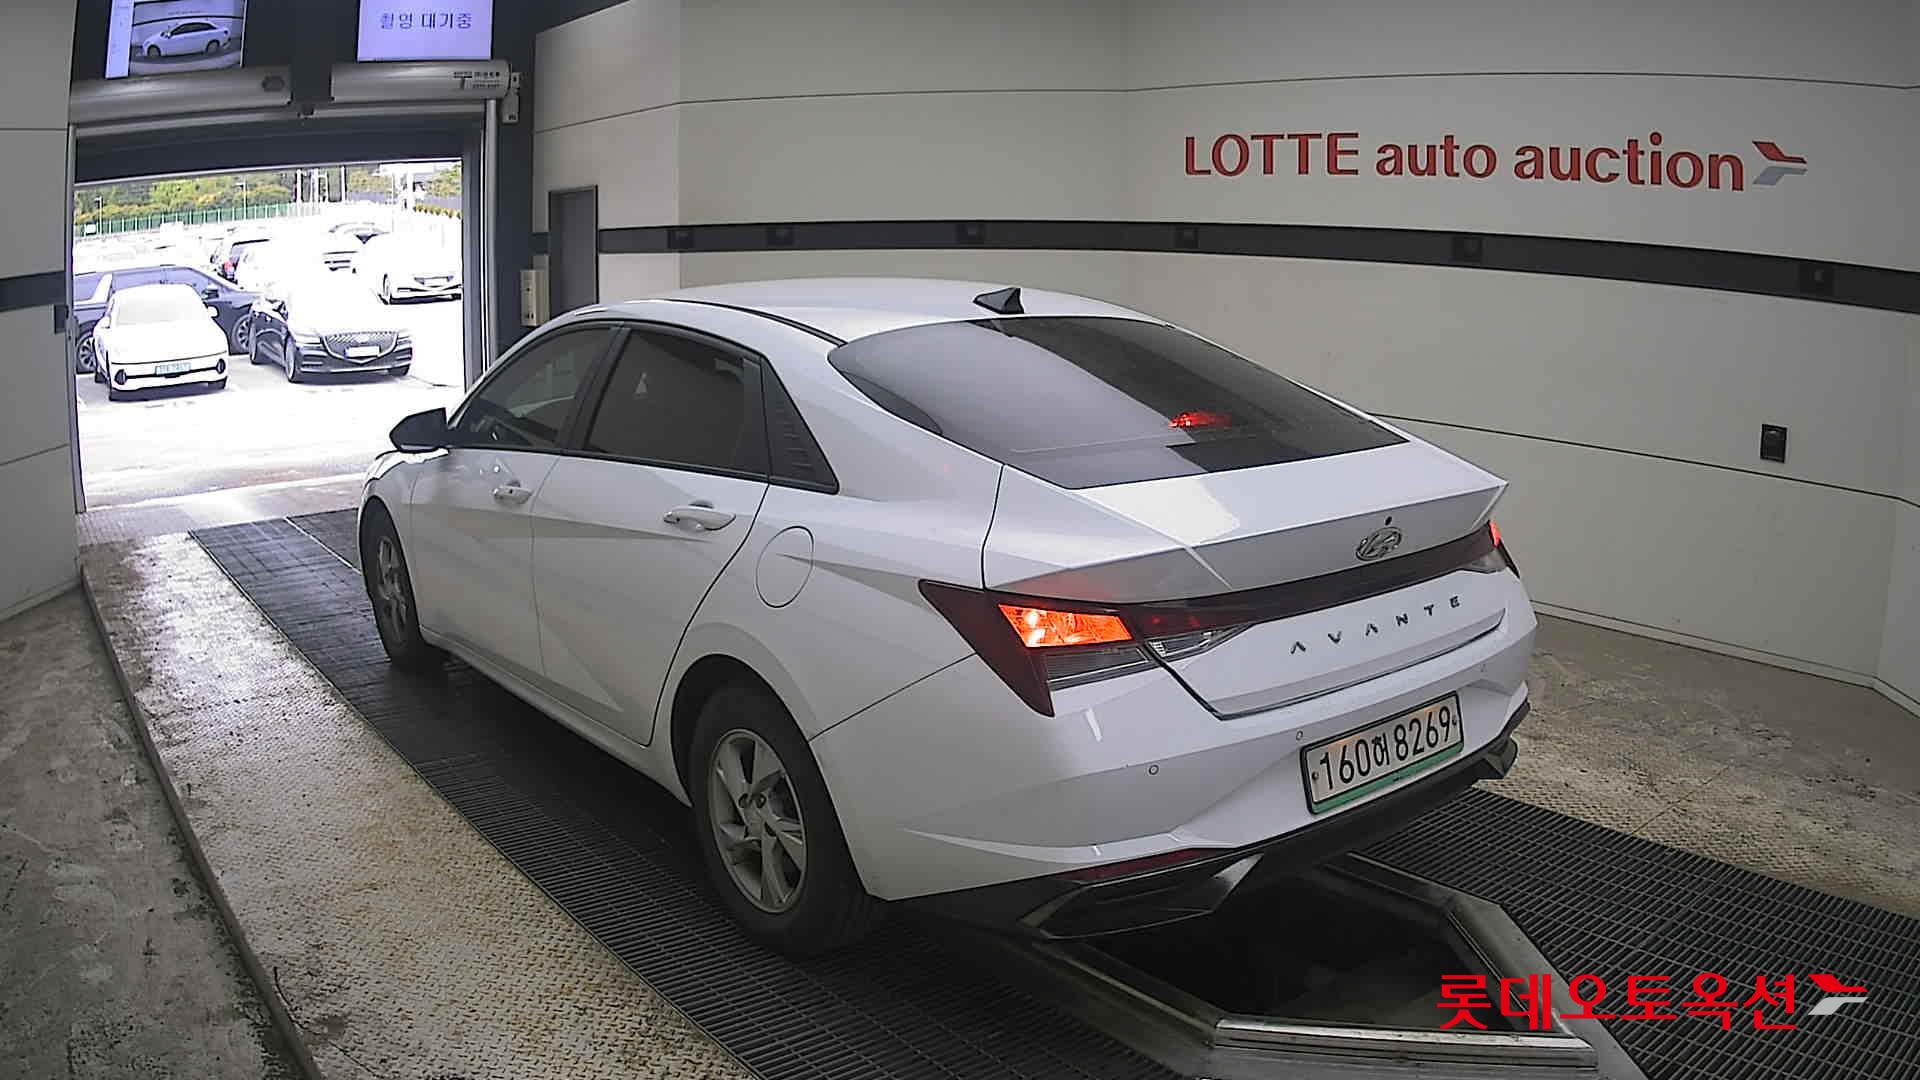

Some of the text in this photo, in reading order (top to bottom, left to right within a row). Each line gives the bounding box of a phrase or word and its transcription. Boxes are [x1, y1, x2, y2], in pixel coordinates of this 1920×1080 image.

[421, 12, 472, 30] 대기중
[1185, 132, 1745, 191] LOTTE auto auction
[1290, 595, 1461, 655] AVANTE
